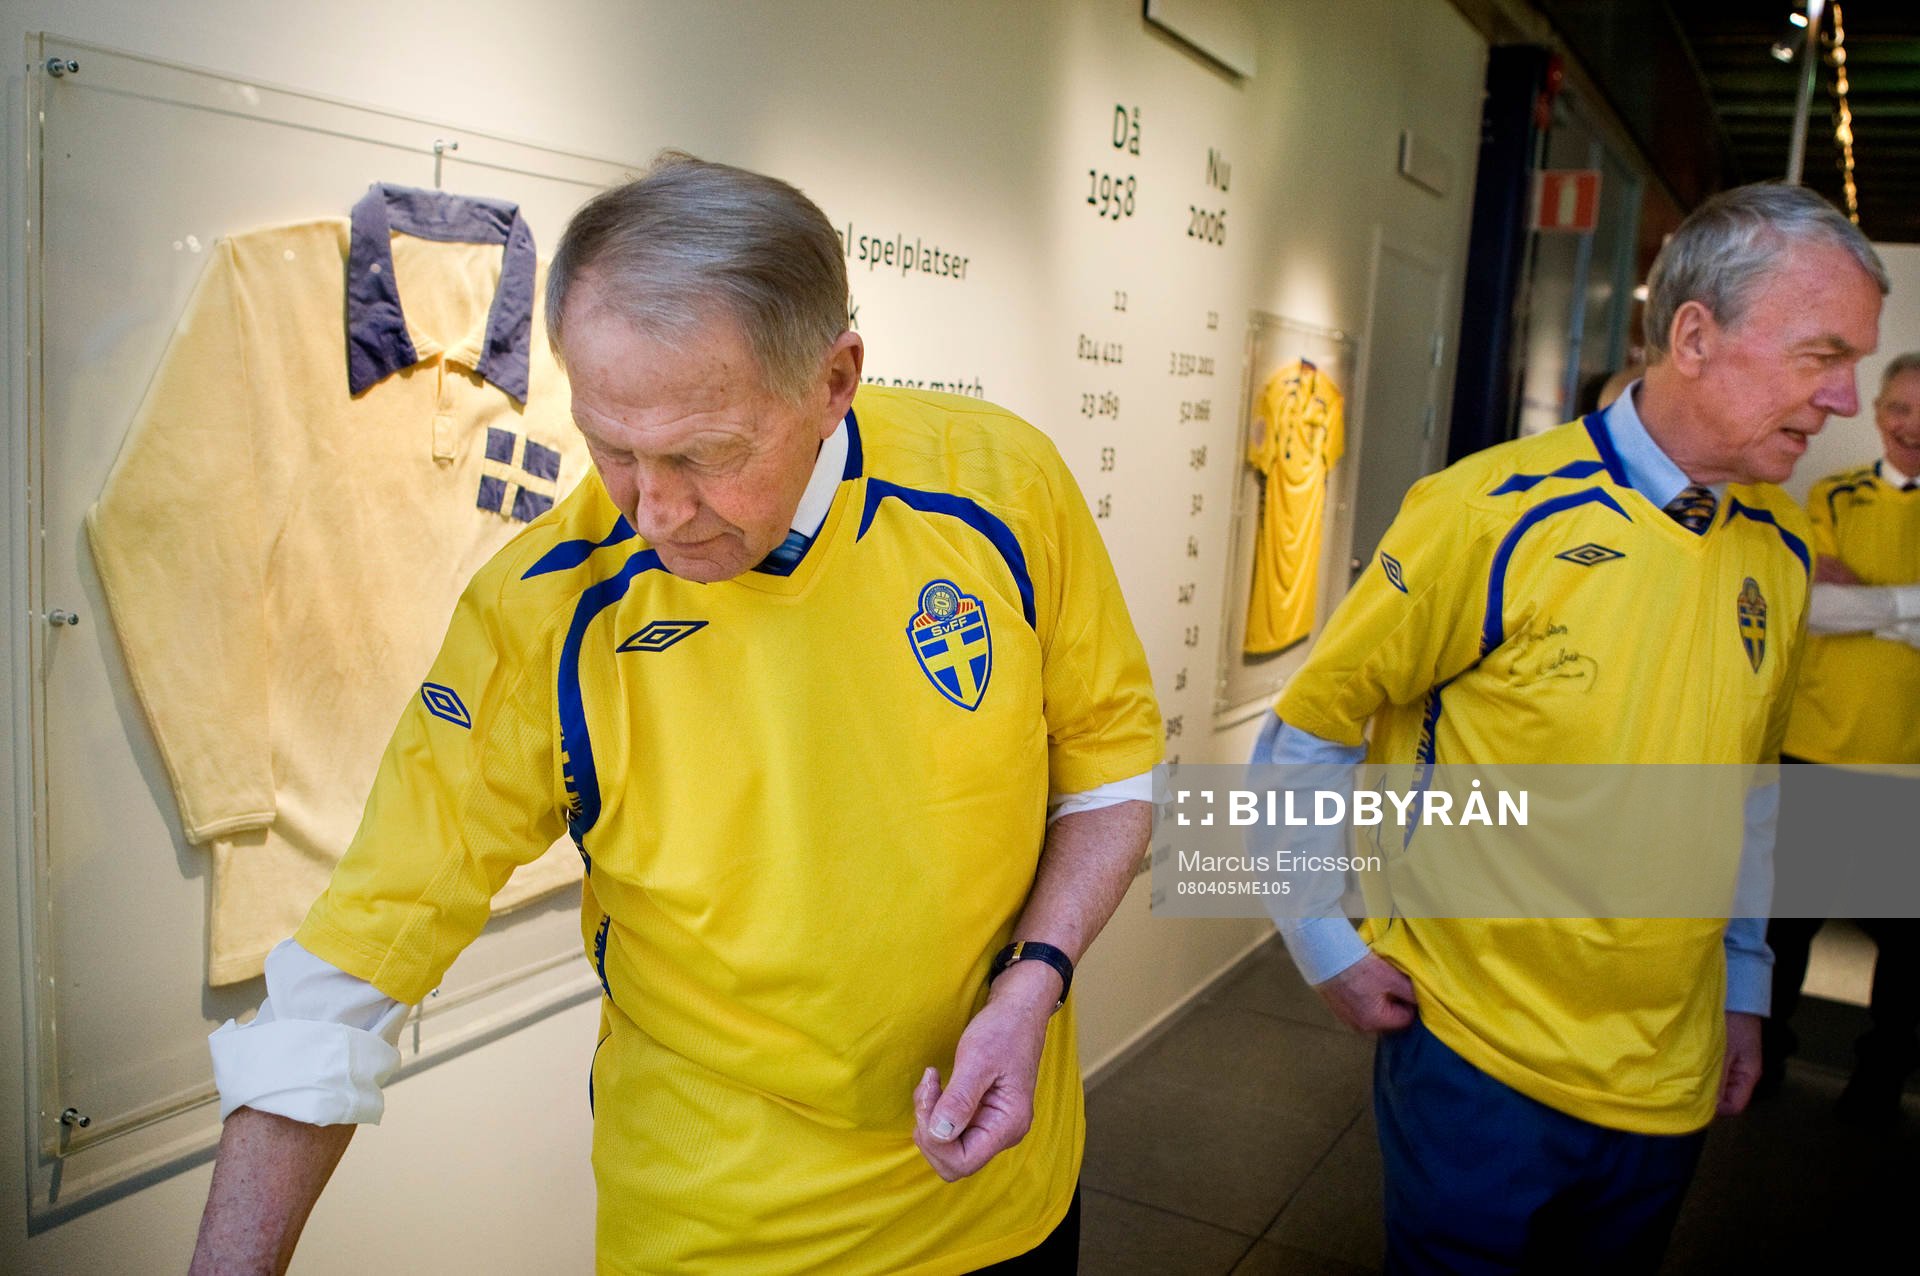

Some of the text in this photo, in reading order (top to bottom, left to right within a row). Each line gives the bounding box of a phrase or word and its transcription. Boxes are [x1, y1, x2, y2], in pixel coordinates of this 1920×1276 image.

[1113, 104, 1140, 156] Då
[1206, 147, 1231, 192] Nu
[1087, 169, 1136, 221] 1958
[1188, 204, 1226, 246] 2006
[859, 233, 969, 280] spelplatser
[931, 616, 967, 637] SvFF
